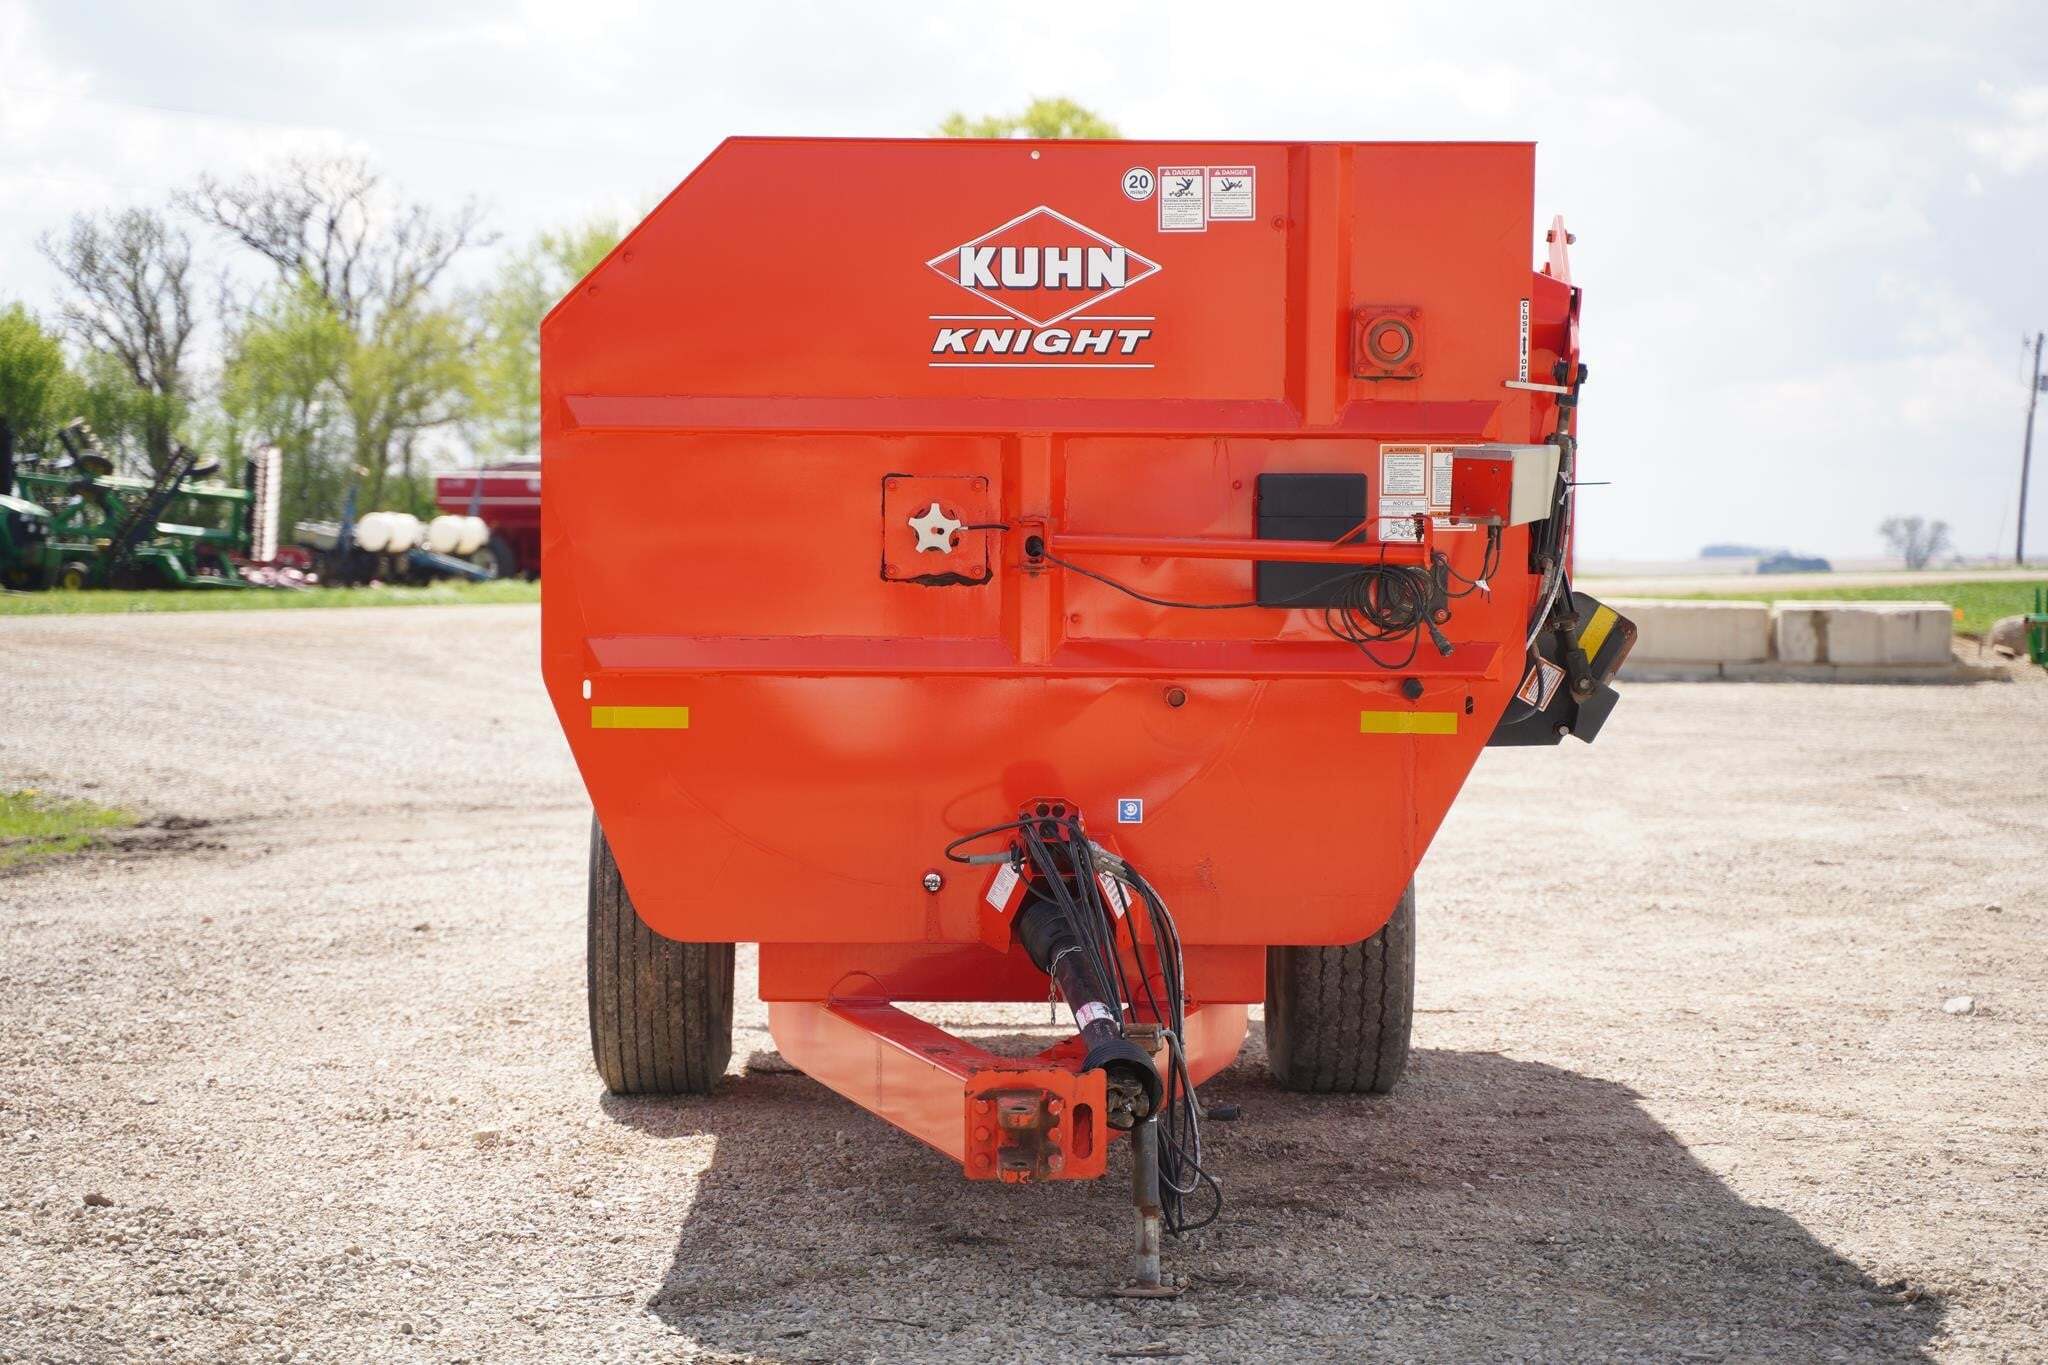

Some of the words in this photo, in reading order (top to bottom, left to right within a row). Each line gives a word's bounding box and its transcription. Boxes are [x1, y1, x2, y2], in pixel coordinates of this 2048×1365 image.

[1128, 175, 1149, 189] 20
[959, 246, 1127, 289] KUHN
[931, 328, 1152, 355] KNIGHT
